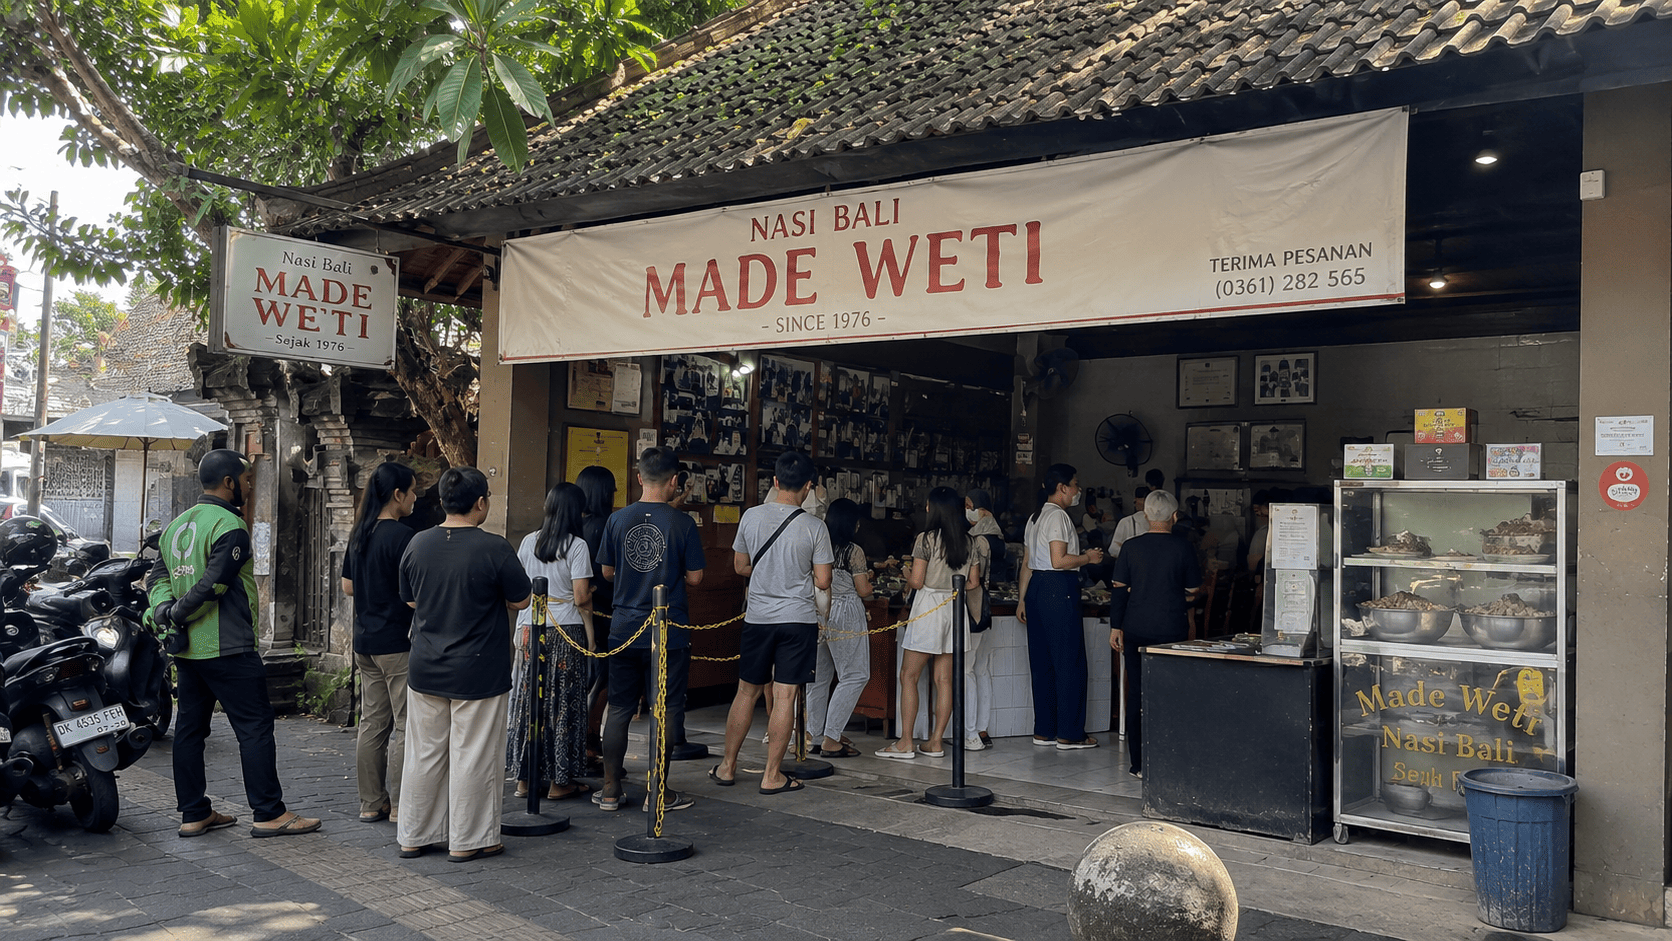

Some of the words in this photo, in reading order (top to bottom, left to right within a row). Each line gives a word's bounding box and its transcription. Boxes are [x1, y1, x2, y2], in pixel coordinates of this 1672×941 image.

[750, 209, 816, 242] NASI
[833, 198, 900, 232] BALI
[282, 251, 317, 269] Nasi
[322, 257, 352, 275] Bali
[643, 247, 818, 318] MADE
[852, 220, 1043, 300] WETI
[1209, 253, 1277, 273] TERIMA
[1283, 242, 1373, 266] PESANAN
[254, 267, 372, 310] MADE
[1215, 275, 1275, 300] (0361)
[1282, 272, 1319, 291] 282
[1328, 267, 1366, 288] 565
[776, 314, 826, 333] SINCE
[833, 311, 871, 330] 1976
[1355, 680, 1445, 717] Made
[57, 723, 73, 735] DK
[1381, 725, 1446, 755] Nasi
